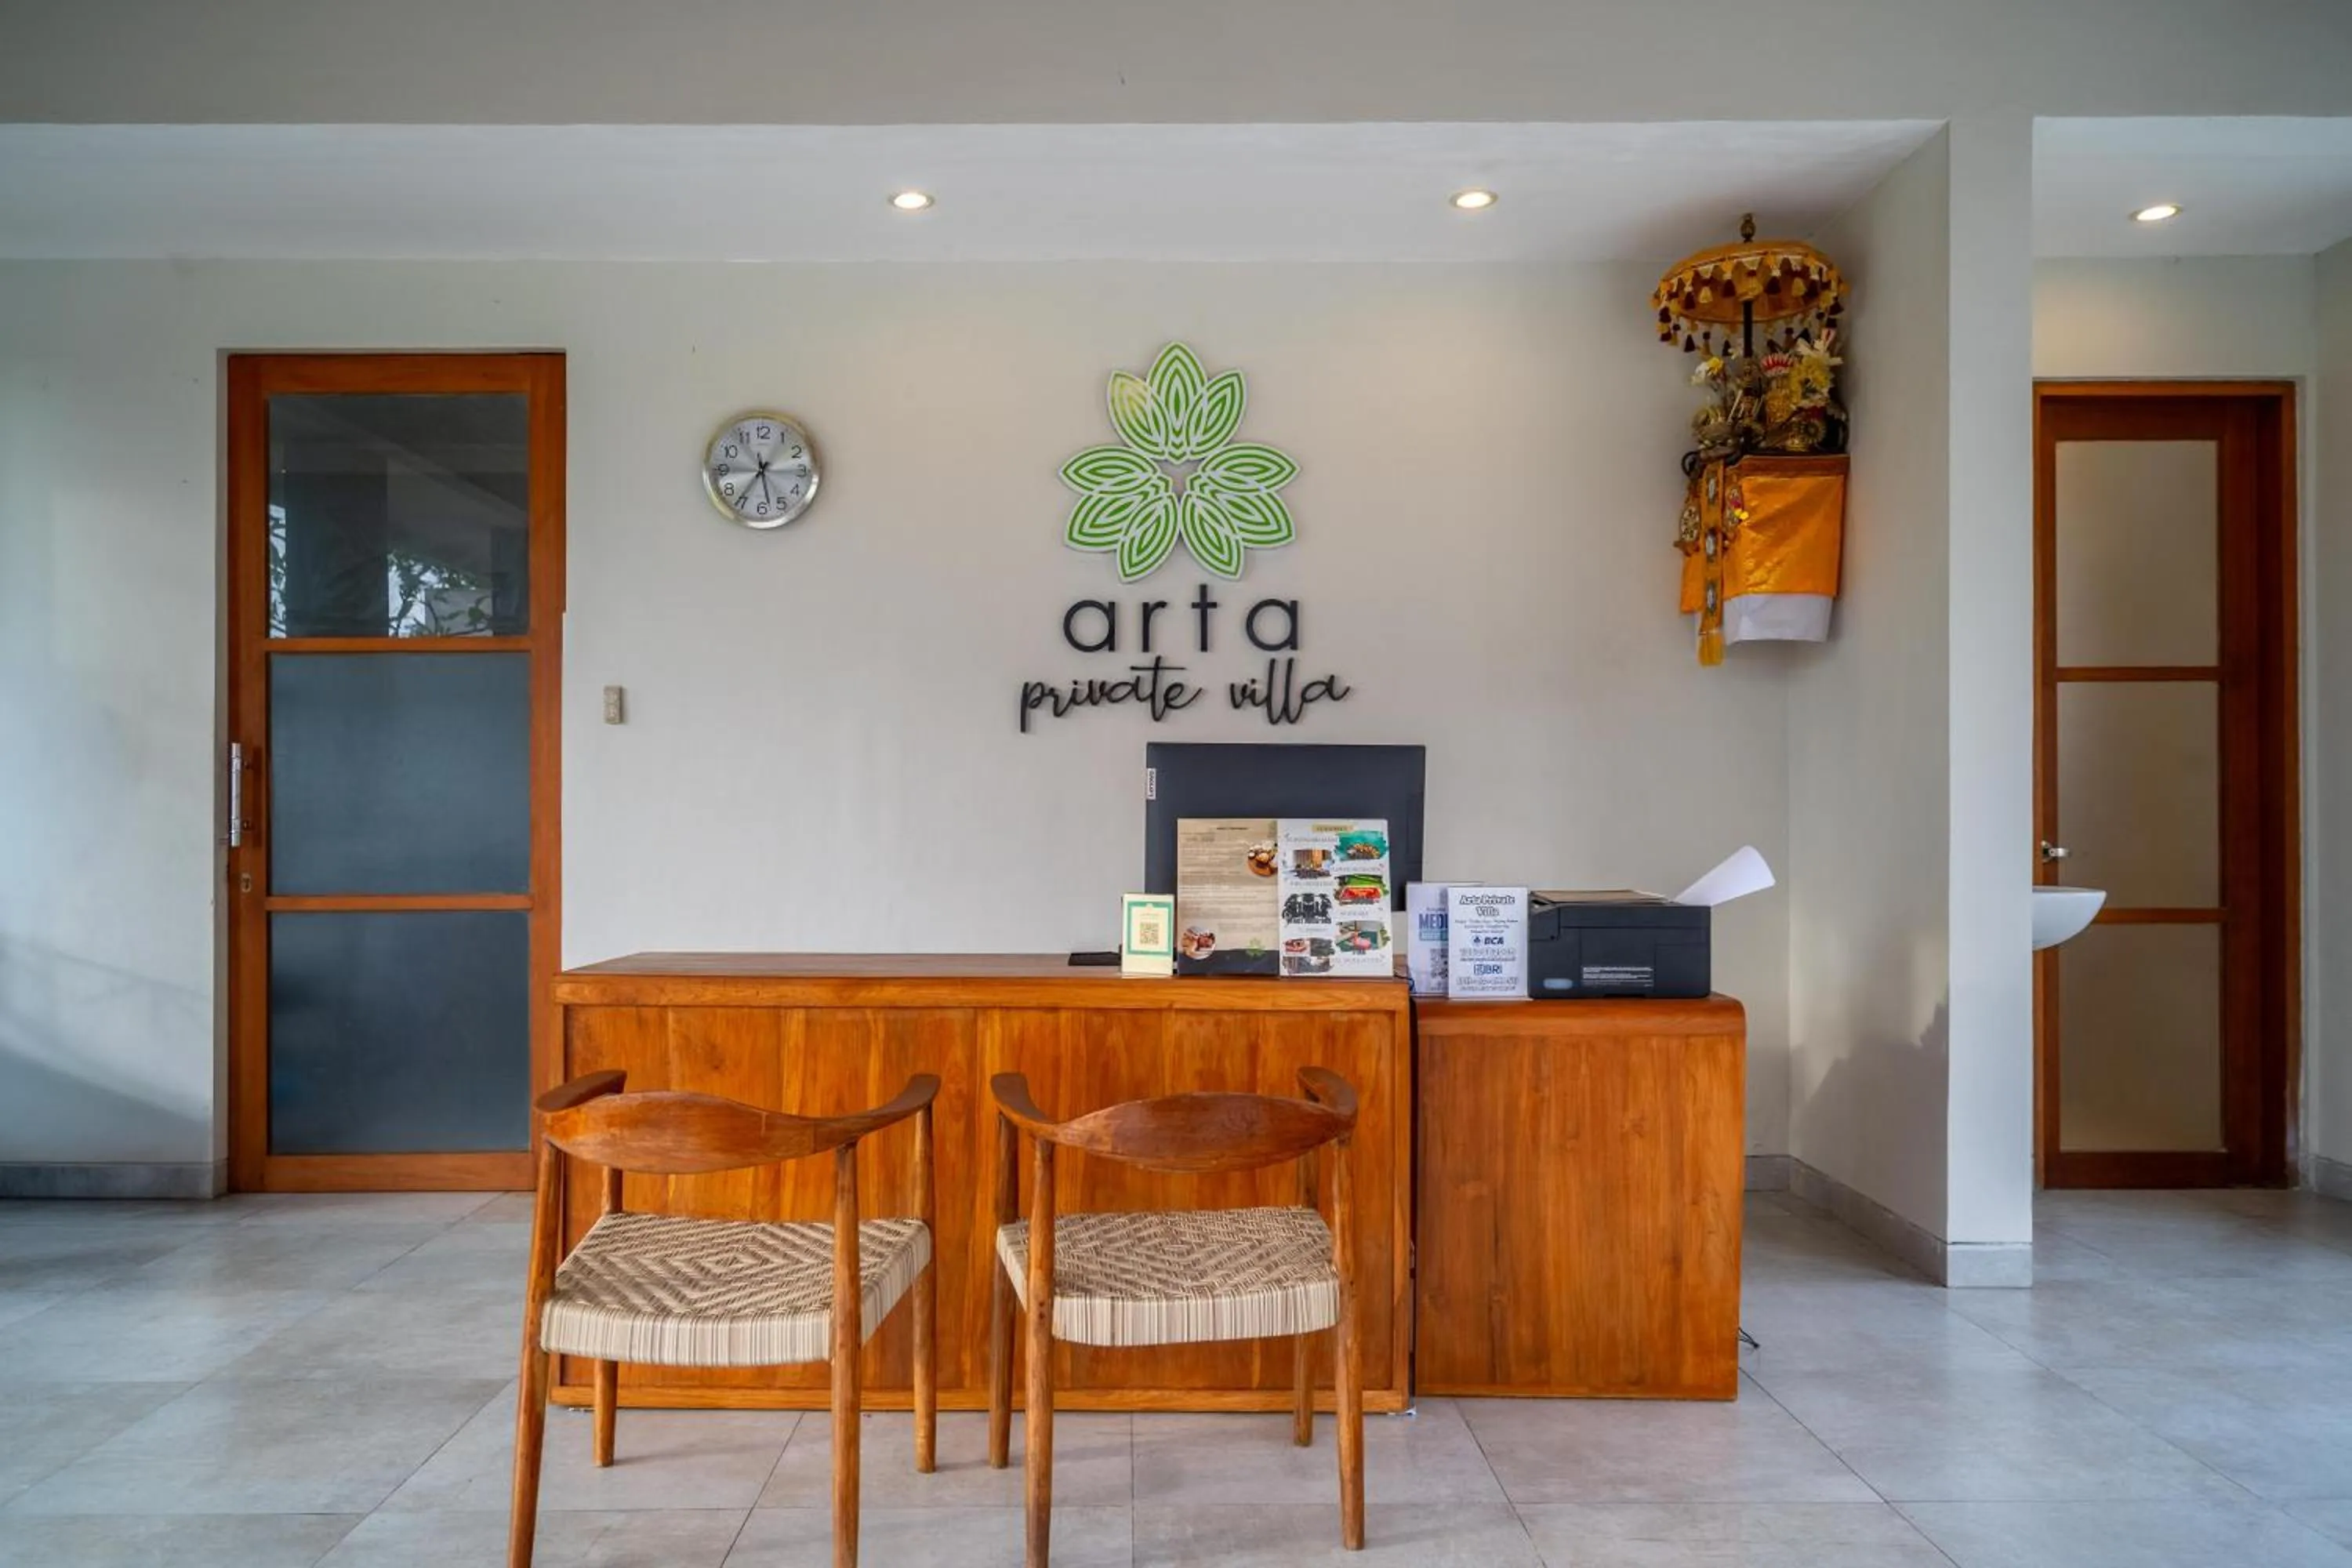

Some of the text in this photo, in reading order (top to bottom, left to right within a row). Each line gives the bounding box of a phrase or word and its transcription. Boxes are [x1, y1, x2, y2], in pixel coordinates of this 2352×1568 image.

[739, 431, 750, 444] 11
[757, 426, 771, 440] 12
[780, 431, 785, 444] 1
[724, 445, 738, 459] 10
[791, 445, 802, 459] 2
[717, 463, 729, 477] 9
[796, 464, 807, 477] 3
[724, 482, 735, 496] 8
[790, 483, 800, 496] 4
[740, 496, 749, 510] 7
[757, 502, 768, 515] 6
[776, 496, 787, 510] 5
[1063, 584, 1299, 652] arta
[1020, 655, 1352, 732] private villa
